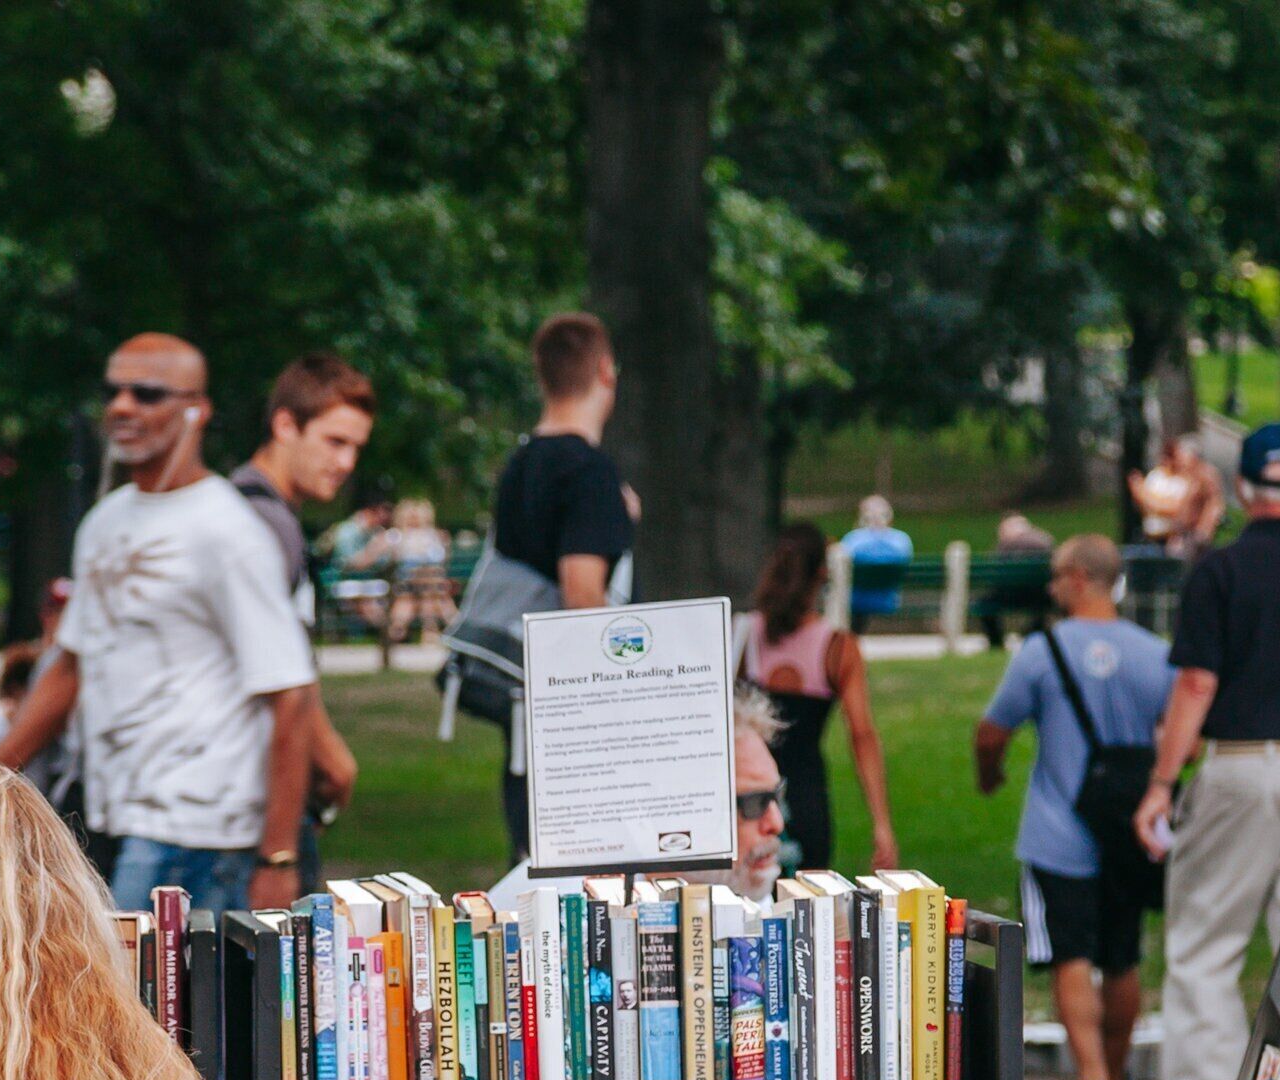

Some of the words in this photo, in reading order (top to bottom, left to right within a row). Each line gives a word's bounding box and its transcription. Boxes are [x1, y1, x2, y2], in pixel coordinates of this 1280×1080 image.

[548, 672, 588, 687] Brewer
[592, 669, 623, 683] Plaza
[626, 666, 674, 680] Reading
[677, 664, 712, 675] Room
[768, 923, 777, 940] THE
[860, 901, 871, 939] Bernardi
[927, 894, 937, 954] LARRY'S
[299, 935, 307, 953] THE
[543, 931, 551, 946] the
[642, 945, 674, 953] BATTLE
[692, 916, 705, 977] EINSTEIN
[167, 949, 177, 1000] MIRROR
[299, 954, 308, 973] OLD
[415, 957, 429, 976] HALL
[458, 942, 473, 988] THEFT
[541, 949, 552, 975] myth
[794, 938, 813, 1002] Innocent
[300, 975, 309, 1006] POWER
[416, 978, 430, 998] PAGE
[506, 950, 523, 1040] TRENTON
[544, 977, 553, 986] of
[693, 983, 704, 992] &
[767, 943, 781, 1016] POSTMISTRESS
[927, 960, 937, 1015] KIDNEY
[438, 962, 454, 1071] HEZBOLLAH
[544, 989, 553, 1018] choice
[859, 976, 873, 1055] OPENWORK
[301, 1008, 310, 1048] RETURNS
[596, 1005, 610, 1076] CAPTIVITY
[773, 1046, 782, 1075] SARAH
